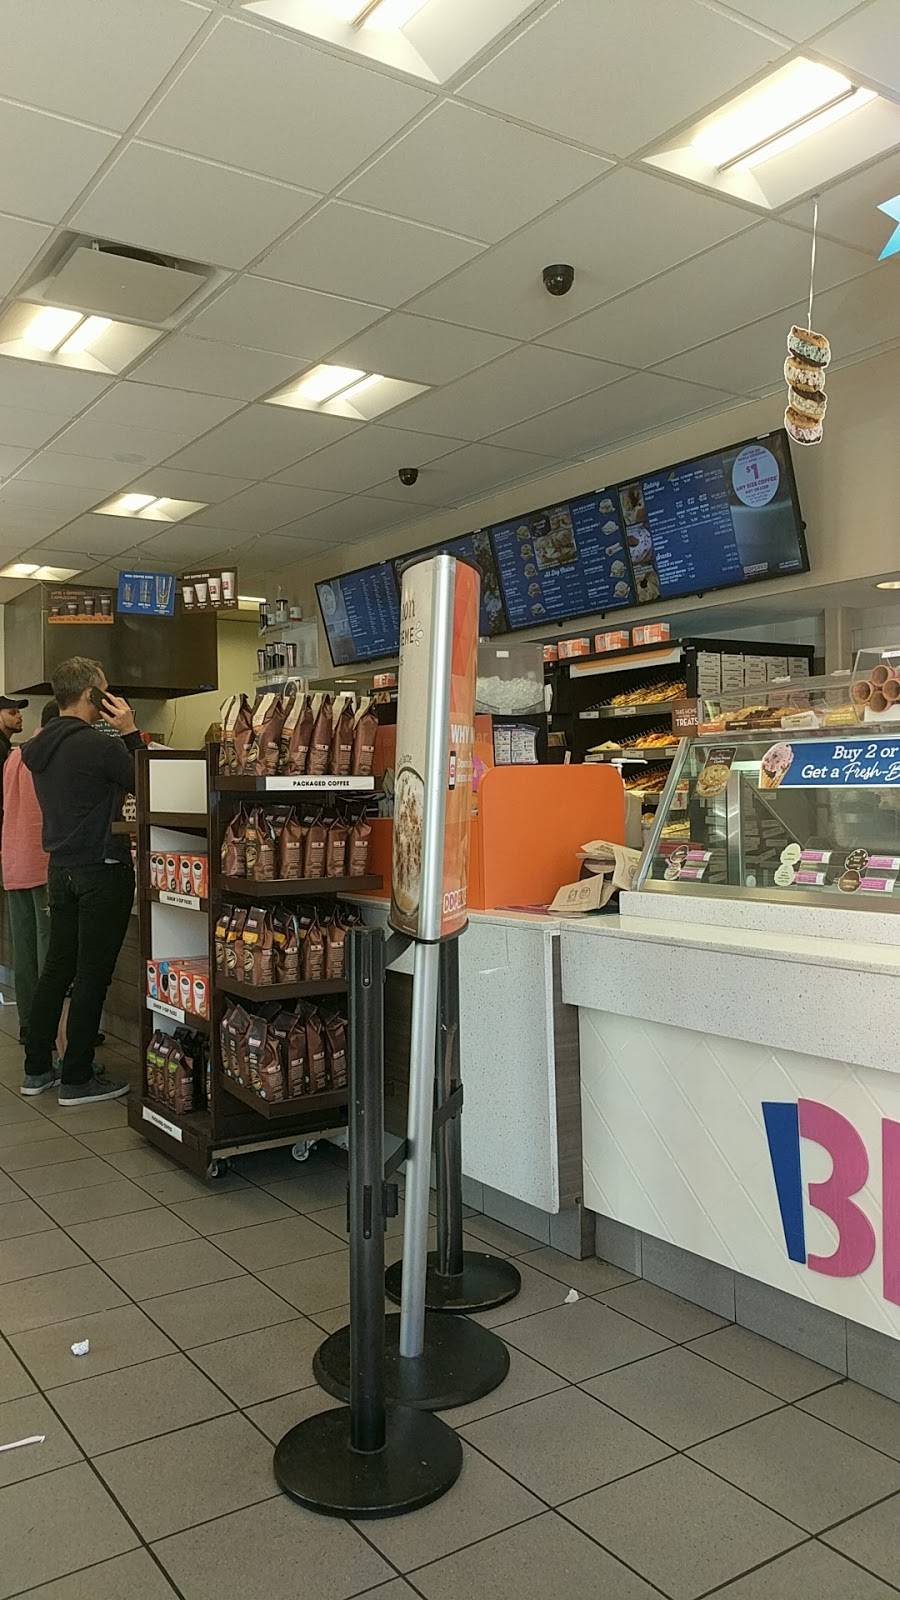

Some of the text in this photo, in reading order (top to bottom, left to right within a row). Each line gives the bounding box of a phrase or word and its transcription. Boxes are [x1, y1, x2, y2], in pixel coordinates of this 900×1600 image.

[745, 463, 759, 480] $1
[675, 717, 699, 727] TREATS
[450, 724, 470, 744] WHY
[832, 744, 899, 762] Buy 2 or
[801, 764, 829, 779] Get
[830, 769, 840, 779] a
